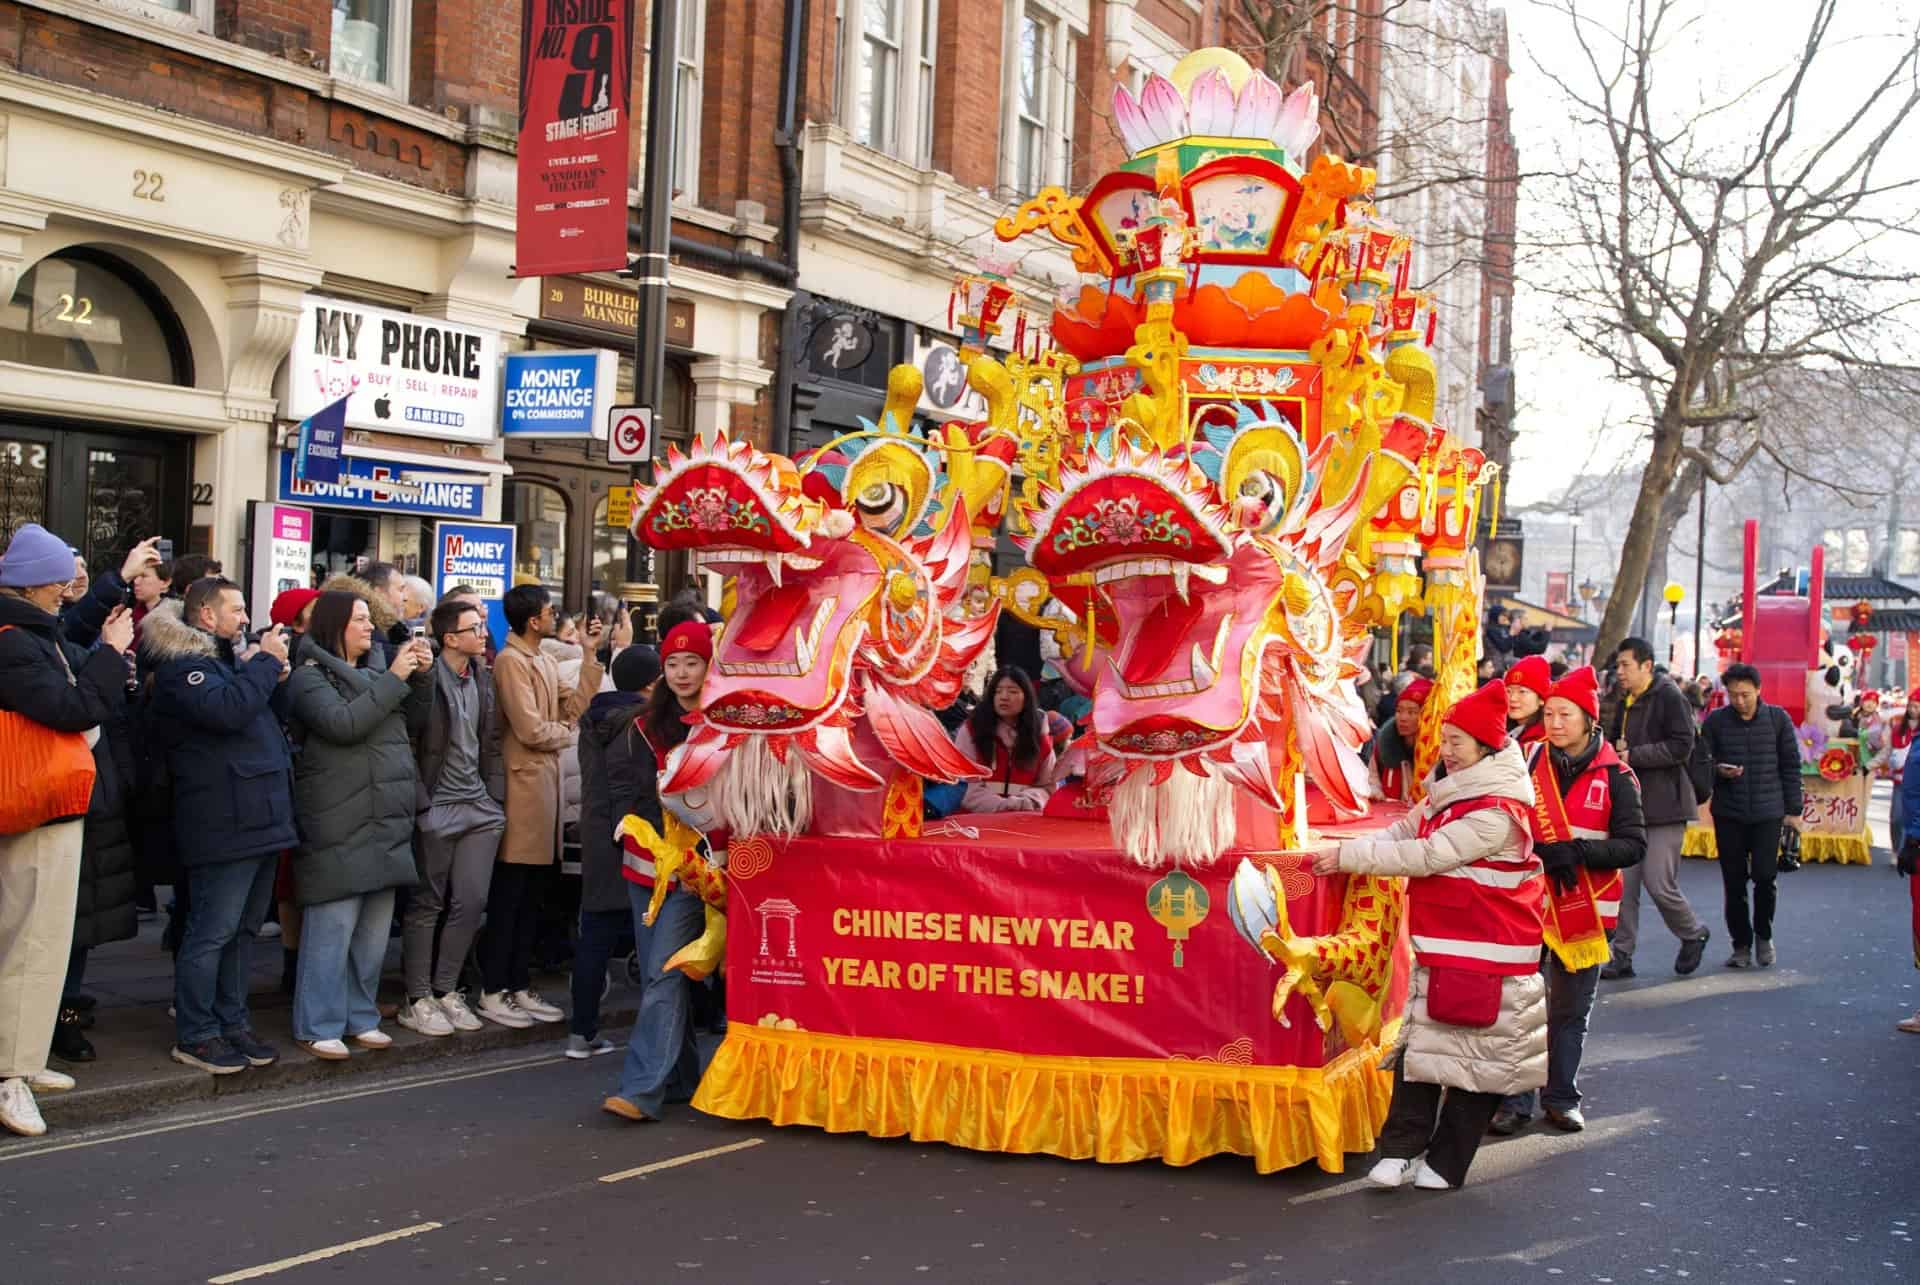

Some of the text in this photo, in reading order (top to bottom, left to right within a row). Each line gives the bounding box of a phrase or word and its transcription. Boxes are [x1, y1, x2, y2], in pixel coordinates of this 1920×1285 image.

[546, 0, 617, 24] INSIDE
[536, 26, 567, 59] NO.
[558, 24, 613, 119] 9
[545, 107, 619, 143] STAGE FRIGHT
[132, 168, 166, 203] 22
[55, 293, 93, 325] 22
[551, 287, 639, 312] 20 BURLEI
[583, 304, 686, 329] MANSIO 20
[314, 306, 482, 380] MY PHONE
[367, 372, 479, 400] BUY SELL REPAIR
[520, 368, 582, 388] MONEY
[506, 388, 593, 408] EXCHANGE
[404, 405, 465, 428] SAMSUNG
[511, 408, 585, 420] 0% COMMISSION
[192, 482, 214, 506] 22
[446, 534, 506, 560] MONEY
[444, 556, 506, 576] EXCHANGE
[833, 907, 1135, 950] CHINESE NEW YEAR
[821, 956, 902, 989] YEAR
[907, 962, 947, 992] OF
[953, 965, 1014, 996] THE
